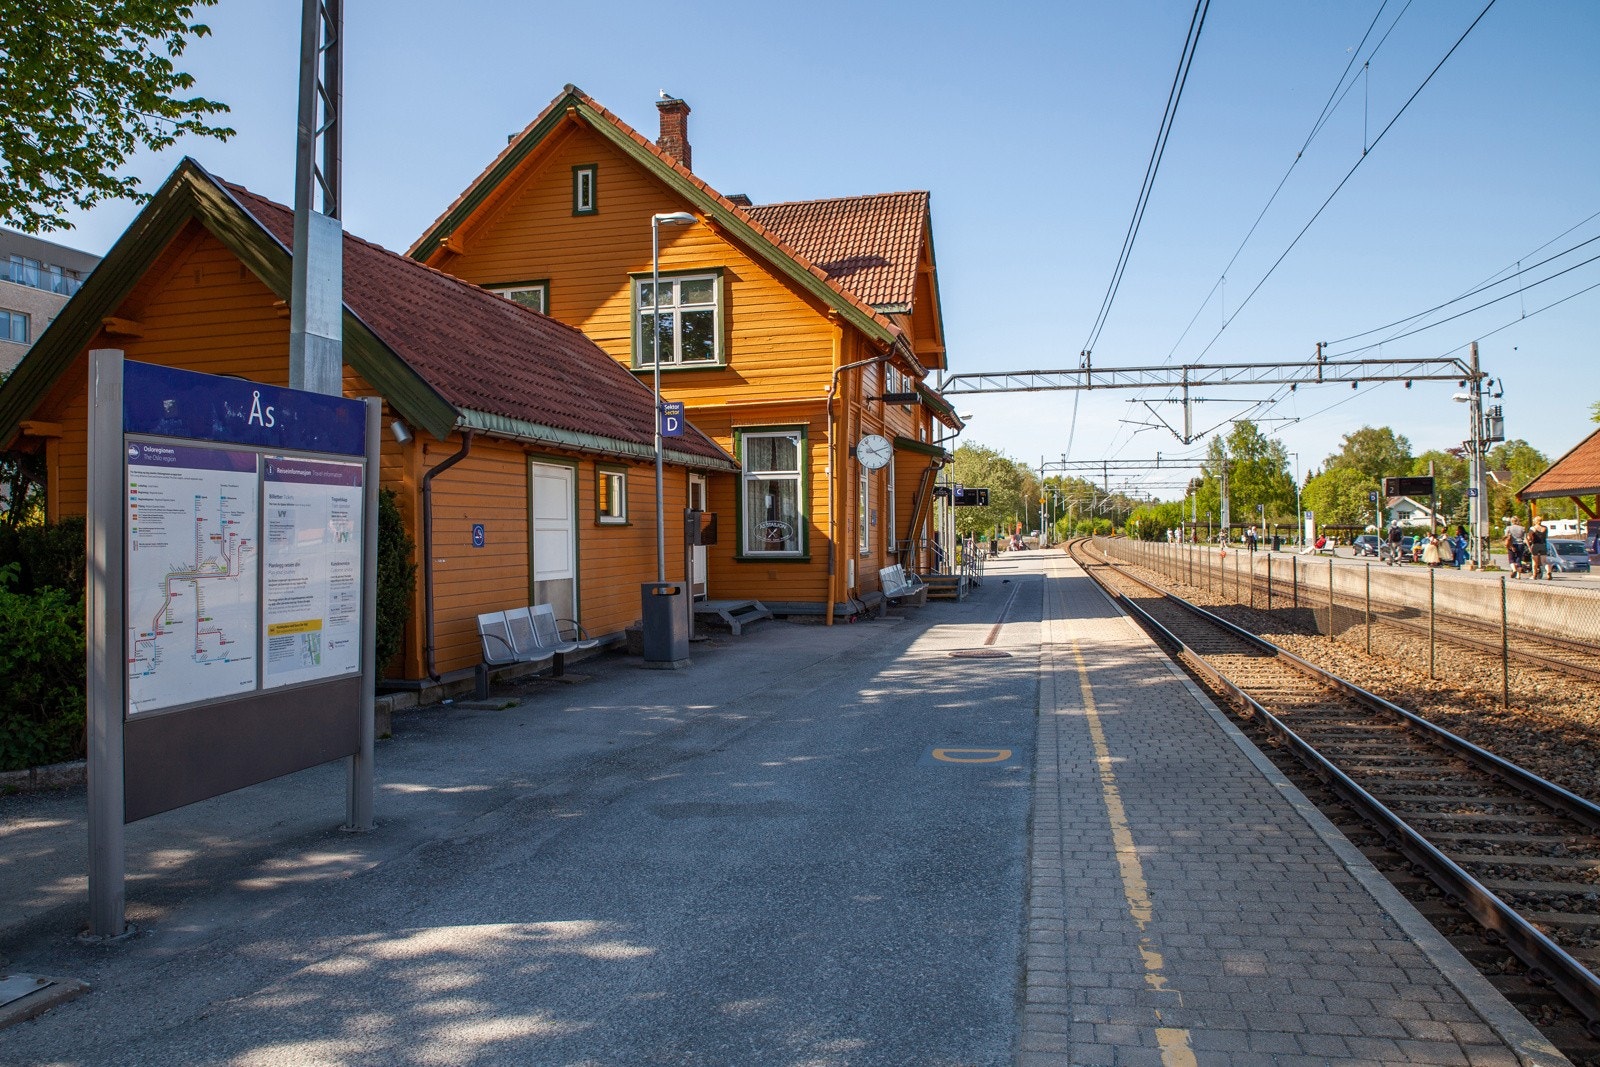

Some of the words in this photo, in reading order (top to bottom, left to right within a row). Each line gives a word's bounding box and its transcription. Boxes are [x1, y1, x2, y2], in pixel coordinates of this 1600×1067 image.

[248, 390, 276, 428] Ås
[667, 417, 678, 432] D
[143, 445, 175, 455] Osloregionen
